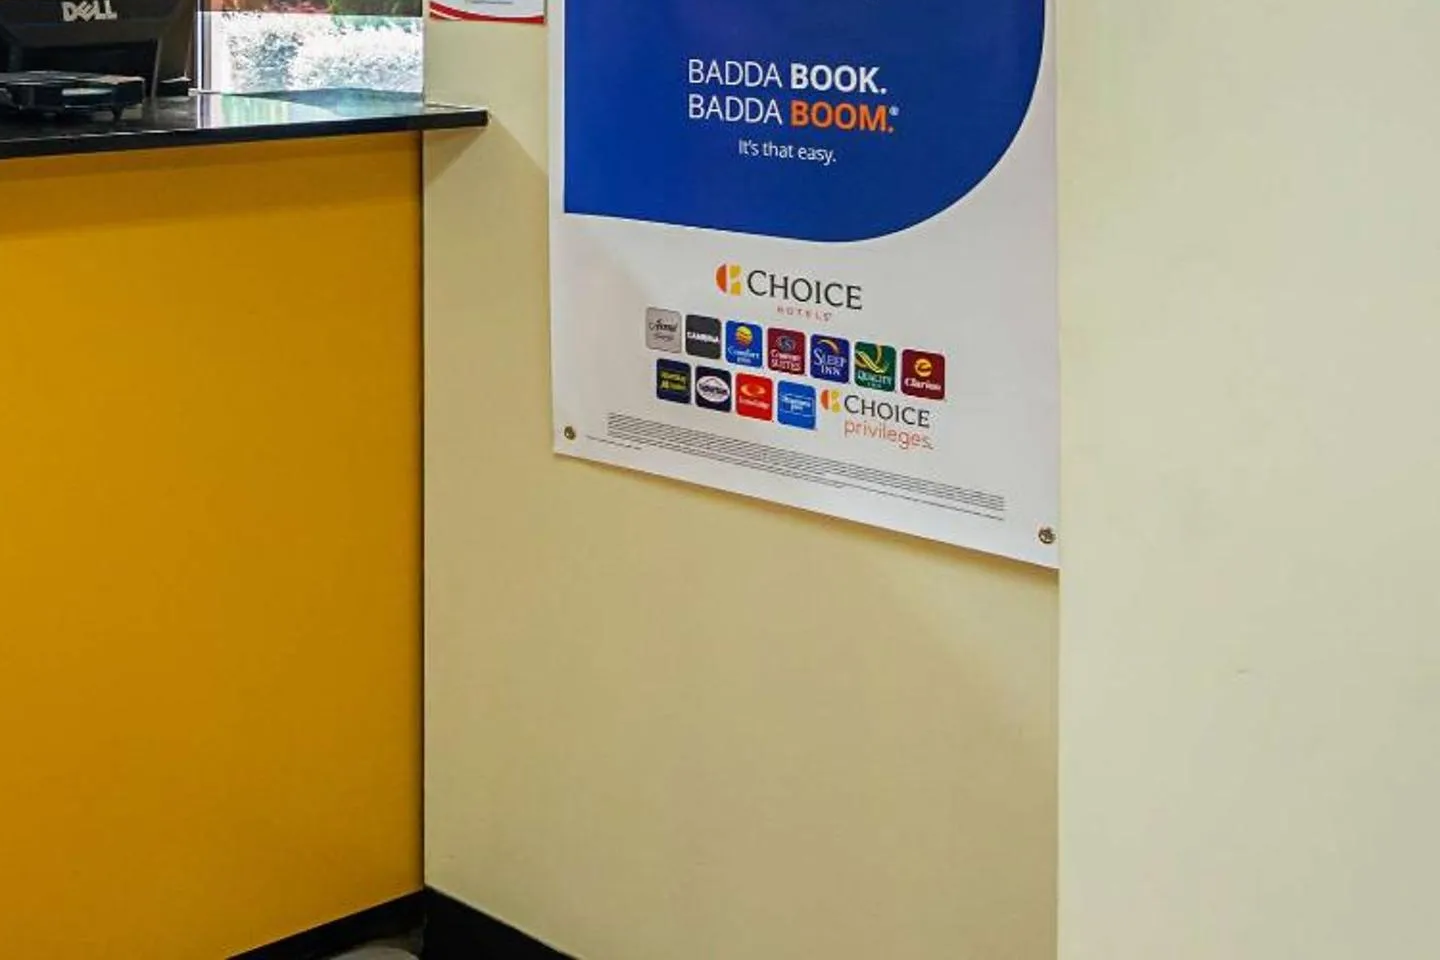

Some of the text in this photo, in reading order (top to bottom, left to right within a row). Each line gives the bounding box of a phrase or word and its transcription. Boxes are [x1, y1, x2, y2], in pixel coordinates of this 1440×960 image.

[62, 0, 117, 22] DELL
[688, 59, 887, 95] BADDA BOOK.
[688, 94, 783, 125] BADDA
[739, 139, 836, 165] It's that easy.
[748, 270, 862, 310] CHOICE
[813, 348, 847, 367] SLEEP
[844, 395, 930, 428] CHOICE
